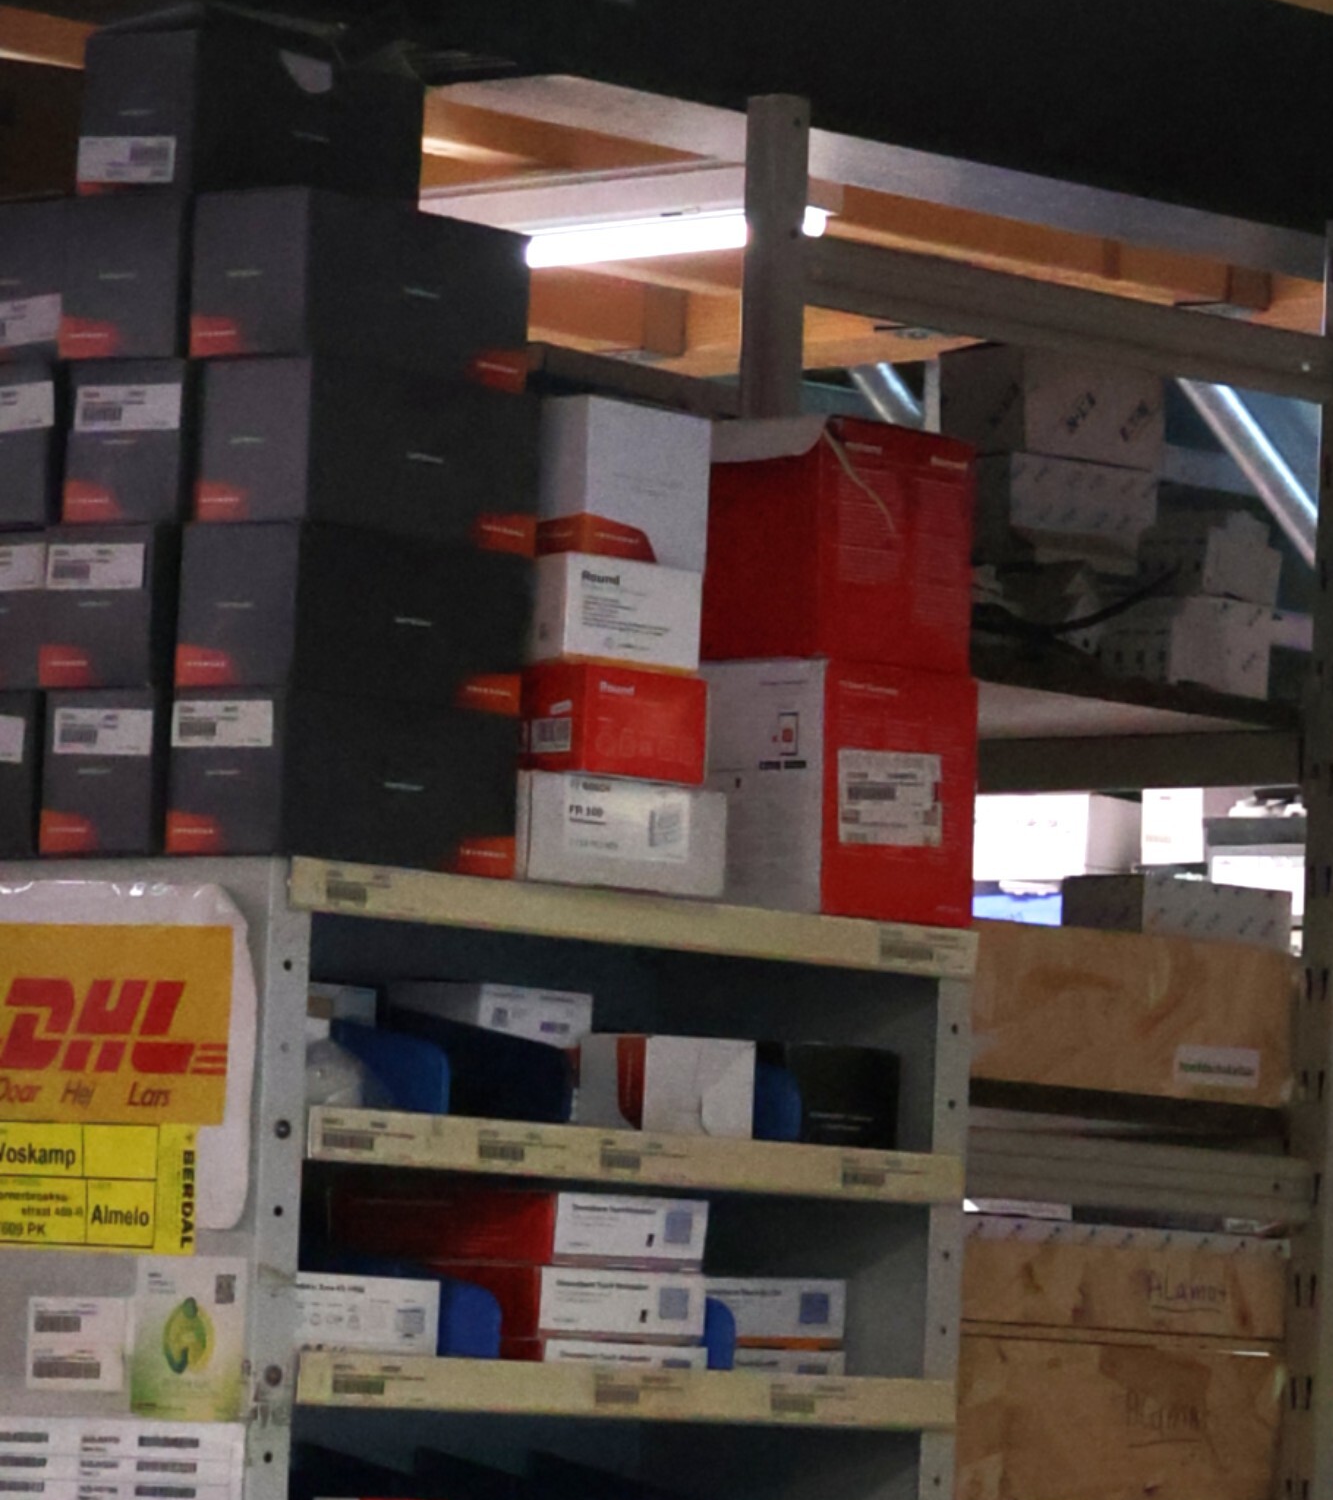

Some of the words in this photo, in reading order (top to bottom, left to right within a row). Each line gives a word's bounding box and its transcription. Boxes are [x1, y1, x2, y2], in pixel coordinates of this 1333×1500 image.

[1, 978, 196, 1075] DHL
[91, 1204, 150, 1227] Almelo
[180, 1150, 195, 1248] BERDAL
